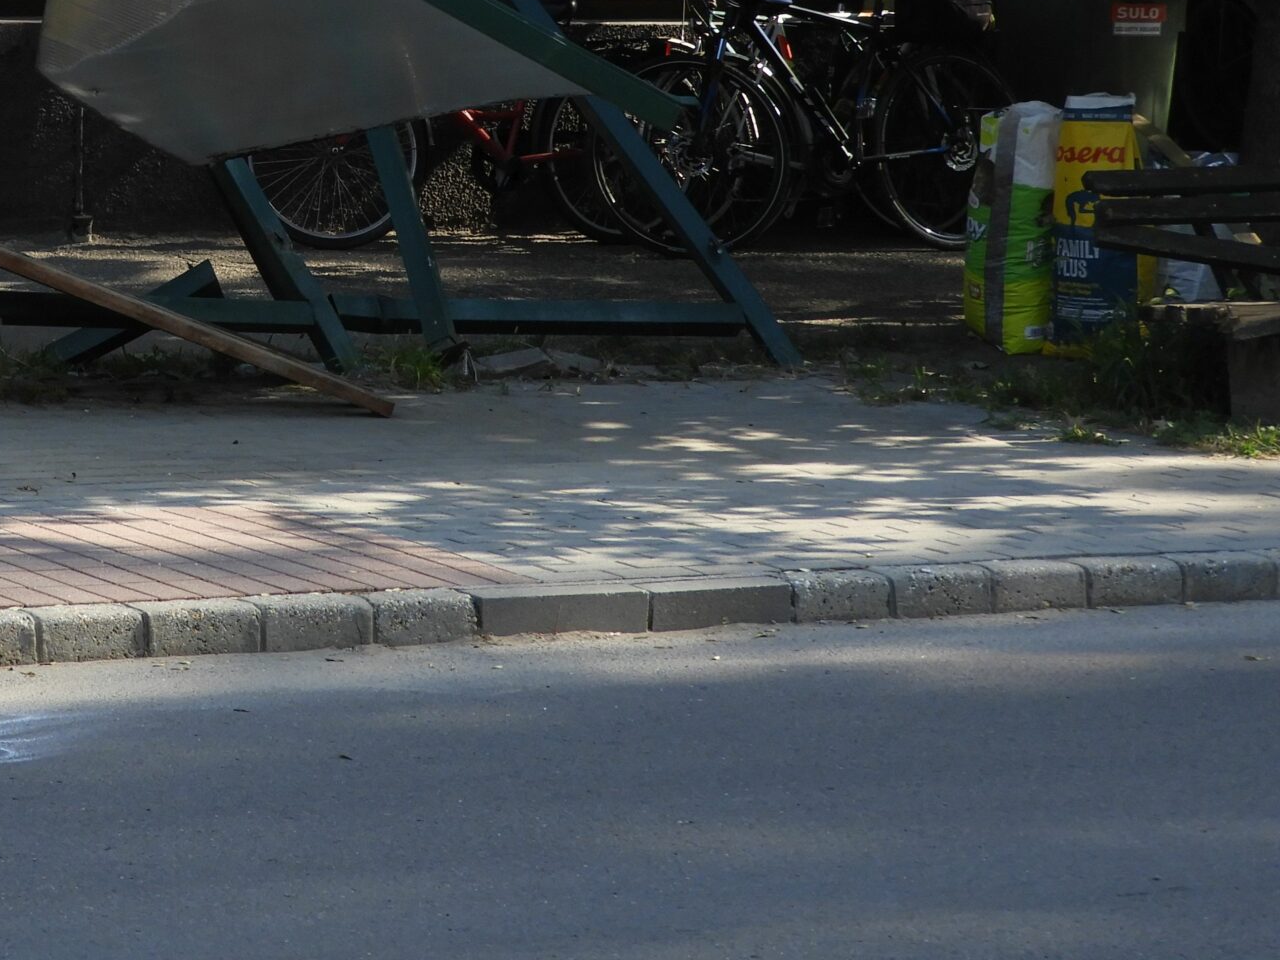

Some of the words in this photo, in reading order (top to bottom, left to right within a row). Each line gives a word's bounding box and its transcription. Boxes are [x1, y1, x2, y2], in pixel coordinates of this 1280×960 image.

[1116, 6, 1160, 20] SULO
[1056, 145, 1127, 164] osera
[1056, 237, 1100, 259] FAMILY
